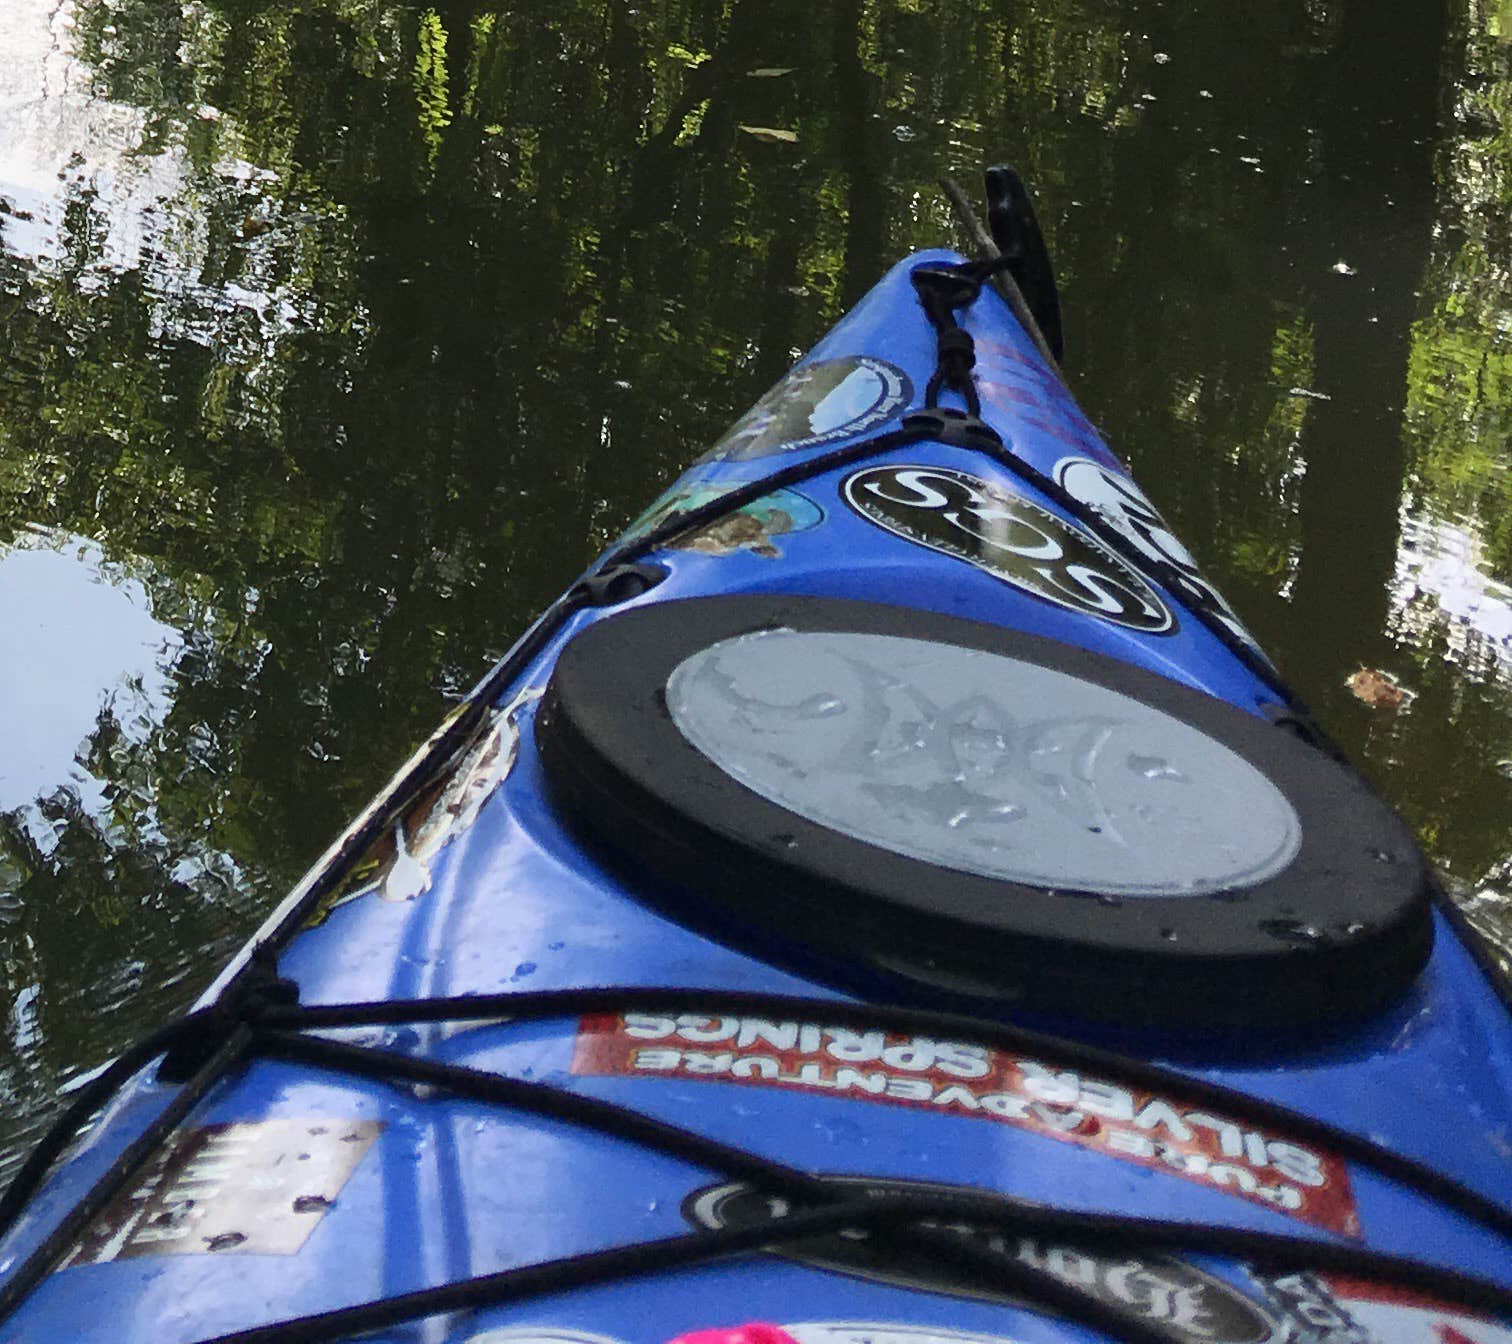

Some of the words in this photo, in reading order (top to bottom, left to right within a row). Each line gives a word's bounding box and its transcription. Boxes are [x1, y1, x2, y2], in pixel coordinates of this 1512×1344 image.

[864, 471, 1161, 618] SGS
[624, 1013, 991, 1078] SPRINGS
[634, 1049, 1084, 1131] ADVENTURE
[1017, 1060, 1326, 1187] SILVER
[1106, 1130, 1303, 1209] PURE
